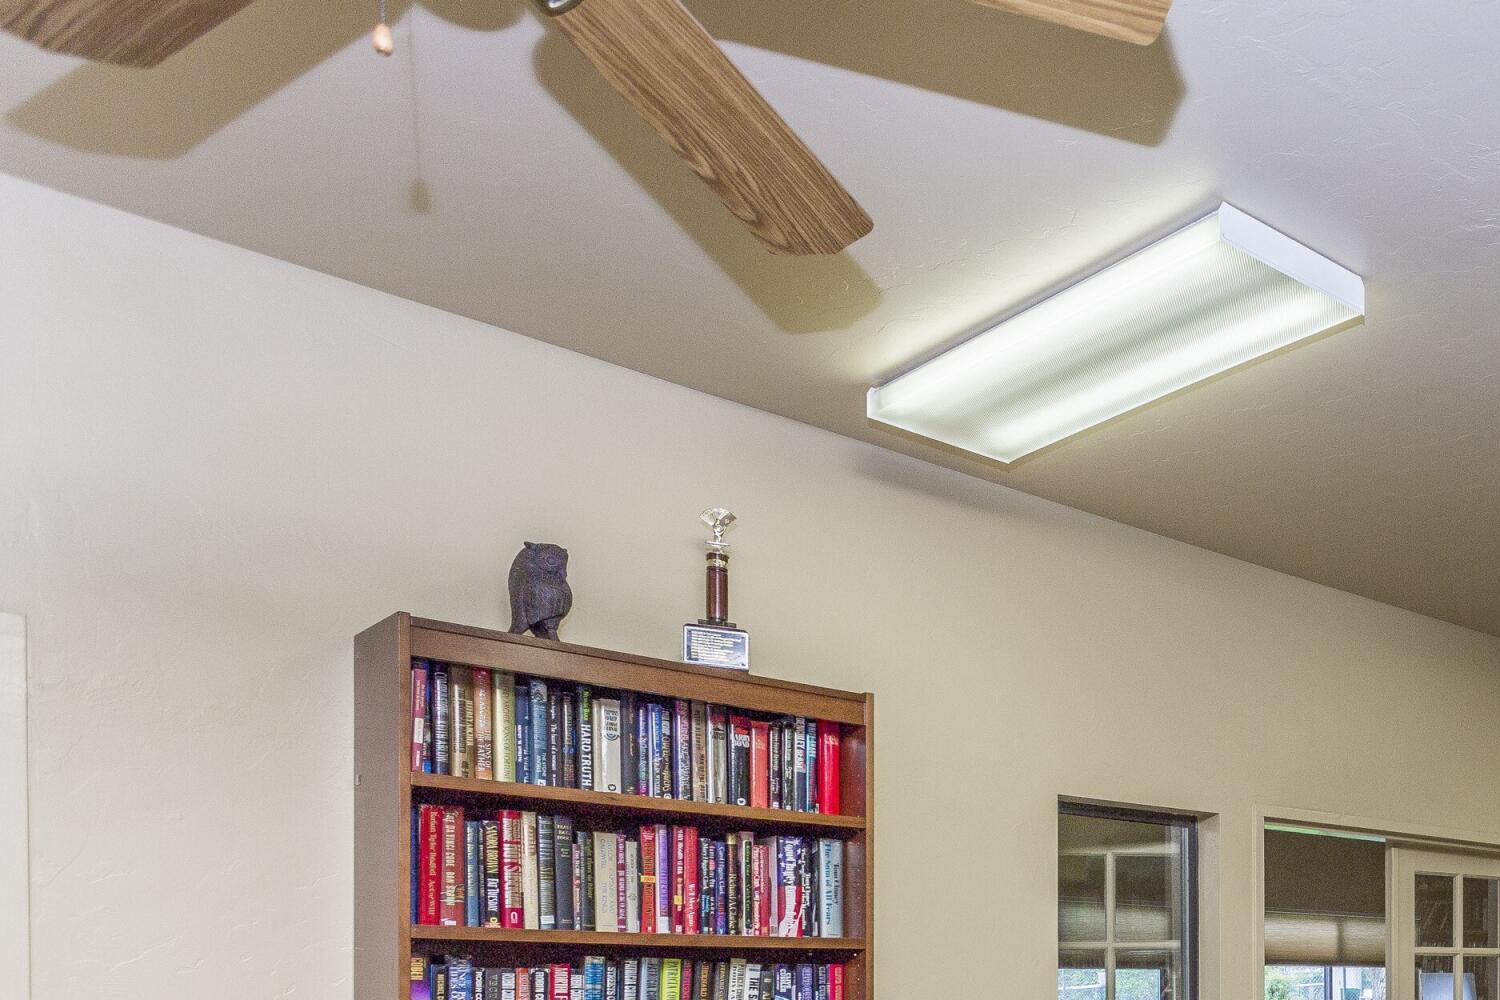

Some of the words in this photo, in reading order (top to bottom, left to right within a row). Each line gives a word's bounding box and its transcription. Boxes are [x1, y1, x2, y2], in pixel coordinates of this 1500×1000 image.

[581, 723, 592, 752] HARD
[581, 754, 592, 787] TRUTH
[446, 824, 456, 834] DA
[486, 826, 498, 849] SANDRA
[446, 834, 456, 850] VINCI
[446, 852, 456, 867] CODE
[486, 850, 498, 874] BROWN
[832, 863, 840, 878] Tom
[446, 871, 456, 884] DAN
[488, 878, 499, 888] FAT
[728, 874, 736, 899] Richard
[825, 878, 832, 888] of
[488, 888, 499, 912] TUESDAY
[831, 880, 840, 905] Clancy
[728, 905, 736, 929] Clarke
[410, 957, 424, 980] COBEN
[501, 972, 514, 989] ROBIN
[622, 960, 636, 984] PATRICIA
[646, 963, 658, 989] PATRICIA
[666, 961, 678, 989] PATRICIA
[734, 964, 745, 988] PATRICIA
[779, 968, 787, 992] CUSSLER
[818, 966, 826, 984] CLIVE
[436, 974, 444, 996] MICHAEL
[519, 972, 529, 1000] ROBIN
[534, 971, 544, 993] ROBIN
[554, 968, 568, 995] MORTAL
[606, 966, 616, 996] STREETS
[750, 976, 760, 992] THE
